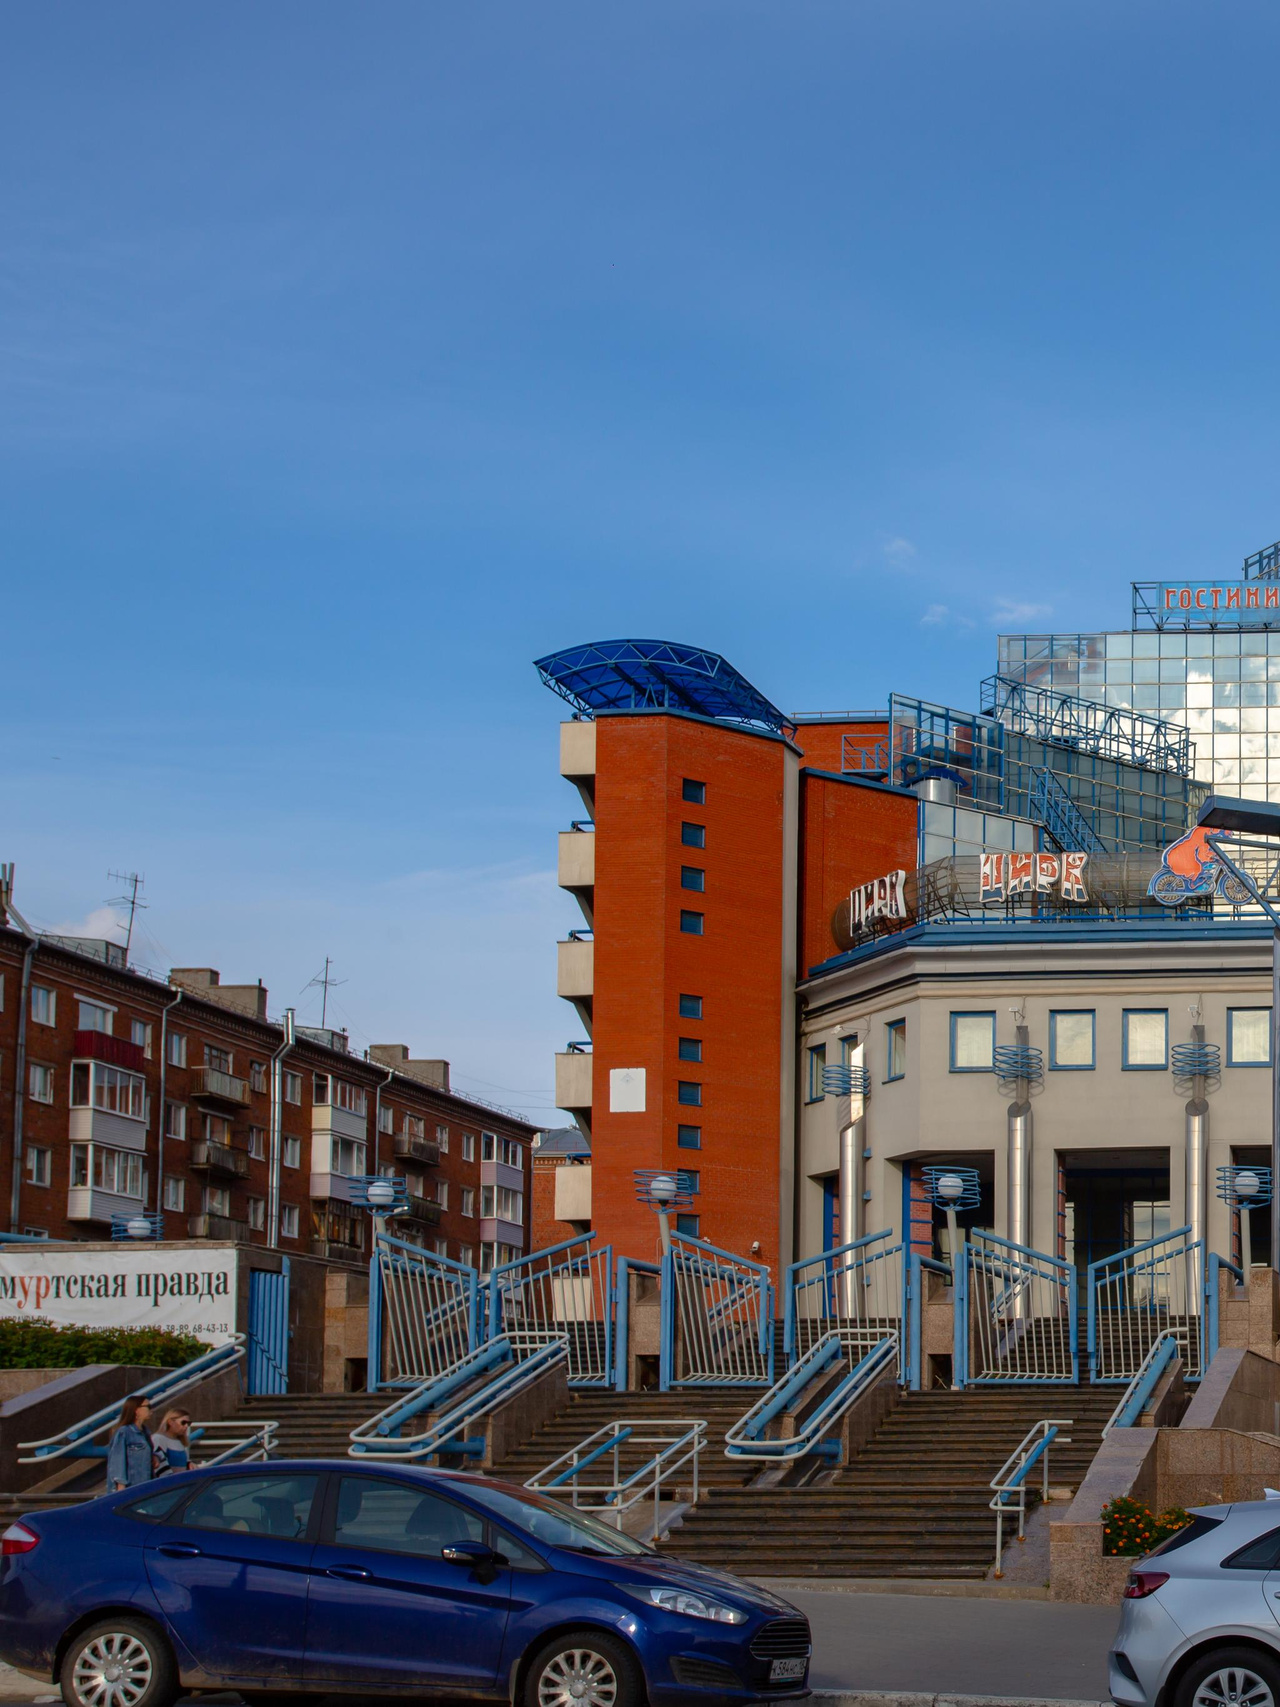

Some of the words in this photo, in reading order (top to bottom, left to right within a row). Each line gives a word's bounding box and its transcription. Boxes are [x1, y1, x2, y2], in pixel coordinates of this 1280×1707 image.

[979, 851, 1089, 903] ЦИРК
[850, 869, 906, 938] ЦИРК
[136, 1271, 230, 1307] правда
[192, 1323, 229, 1334] 68-43-13
